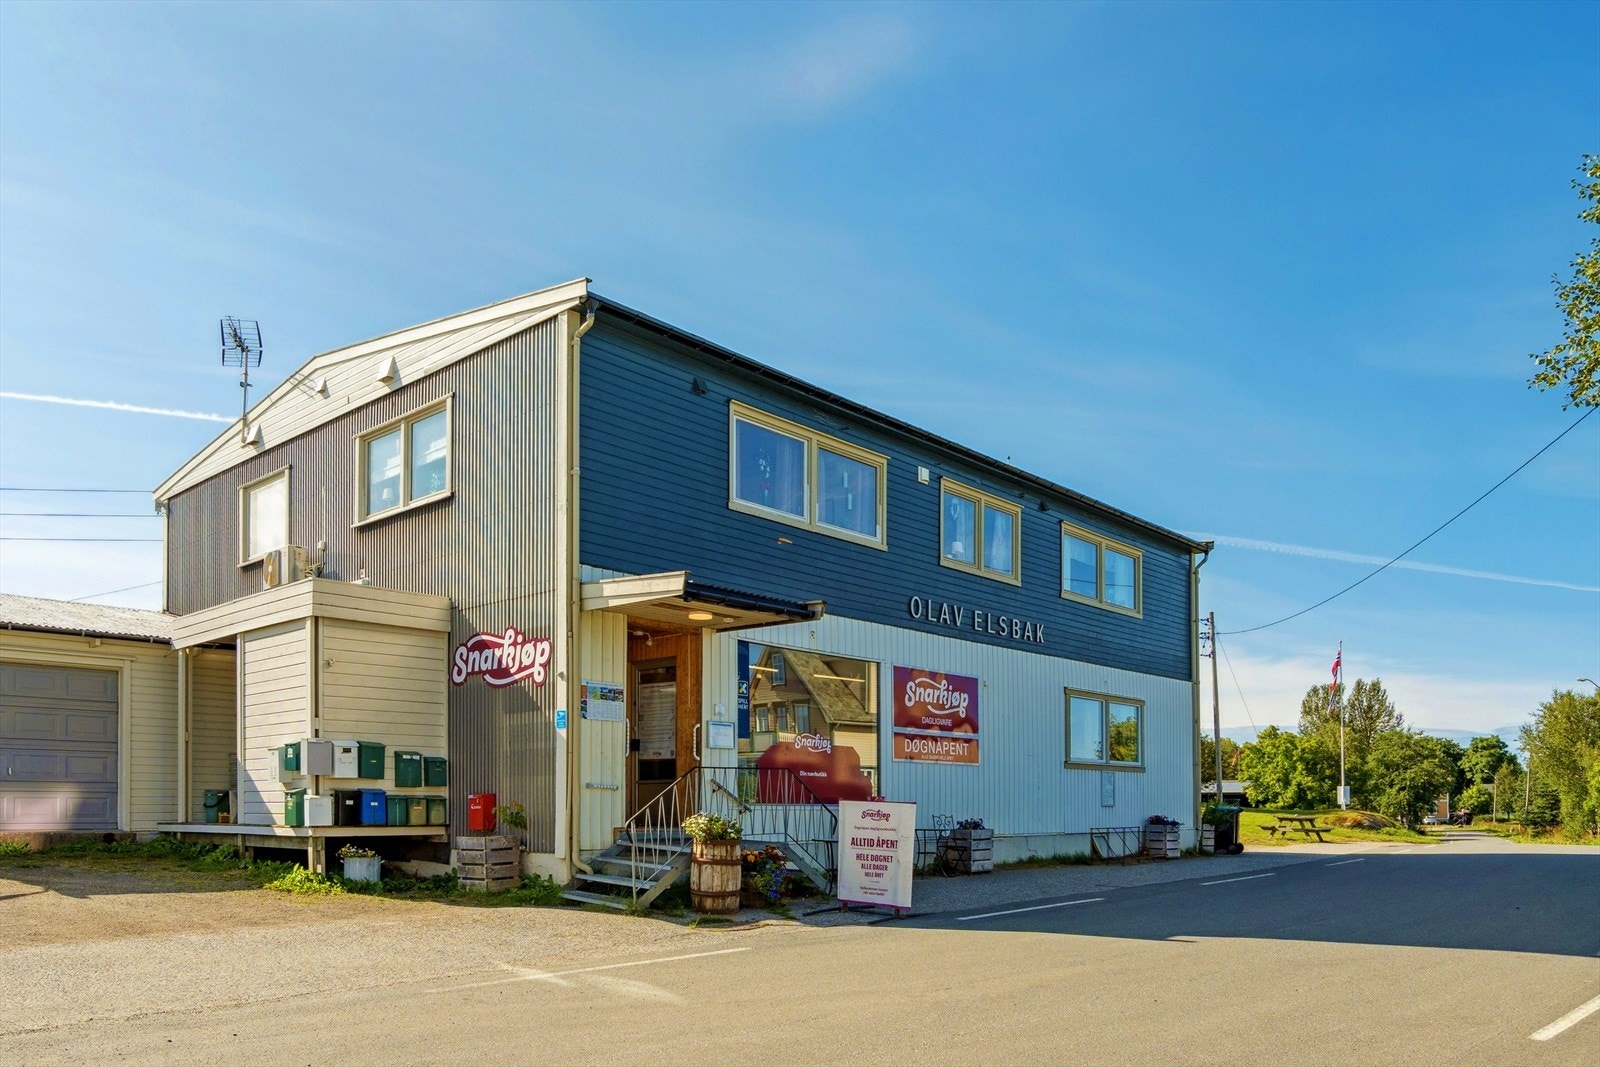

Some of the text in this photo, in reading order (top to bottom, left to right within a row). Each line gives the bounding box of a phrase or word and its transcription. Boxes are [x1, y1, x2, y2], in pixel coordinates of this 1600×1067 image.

[910, 596, 1046, 644] OLAV ELSBAK
[452, 628, 550, 685] Snarkjøp
[904, 677, 969, 718] Snarkjøp
[921, 716, 953, 727] DAGLIGVARE
[904, 737, 969, 756] DØGNÅPENT
[861, 809, 891, 822] Snarkjøp
[851, 836, 898, 849] ALLTID ÅPENT
[855, 853, 893, 863] HELE DØGNET
[861, 863, 888, 872] ALLE DAGER
